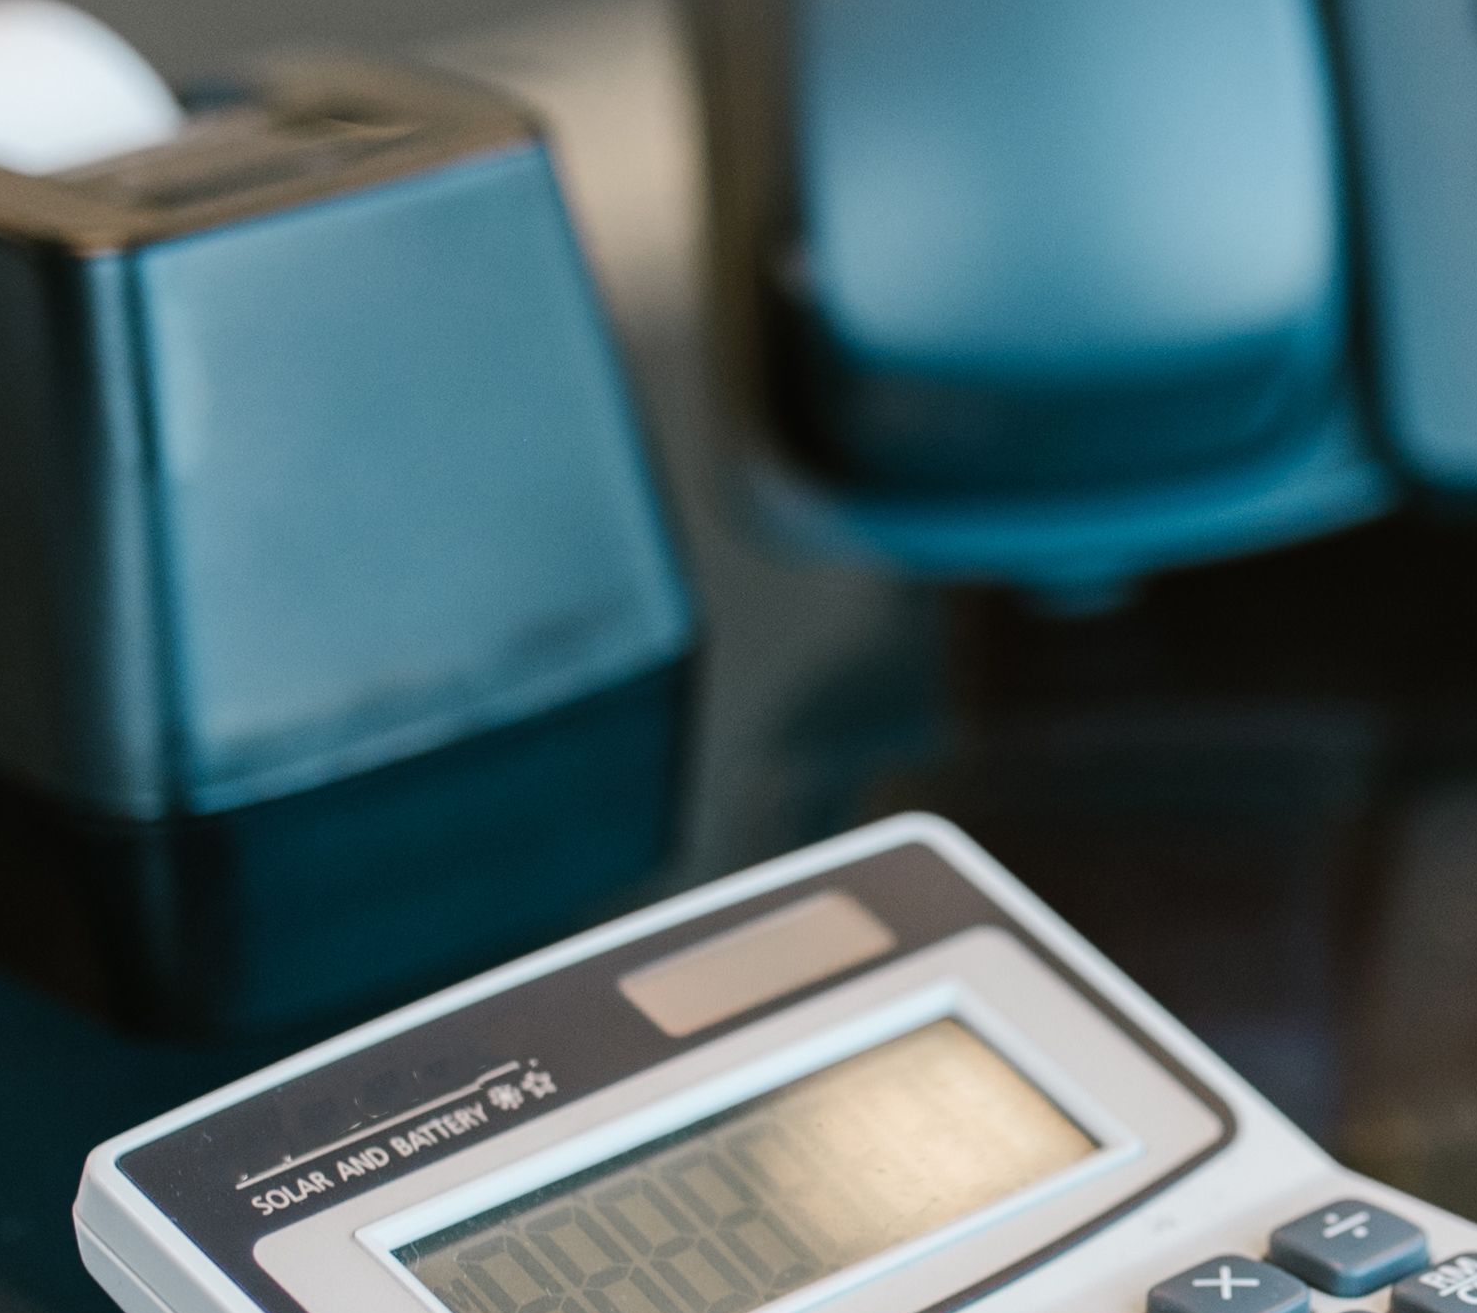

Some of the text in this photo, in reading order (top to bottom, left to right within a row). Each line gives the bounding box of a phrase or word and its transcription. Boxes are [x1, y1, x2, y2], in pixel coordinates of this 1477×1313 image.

[252, 1101, 490, 1217] SOLAR AND BATTERY
